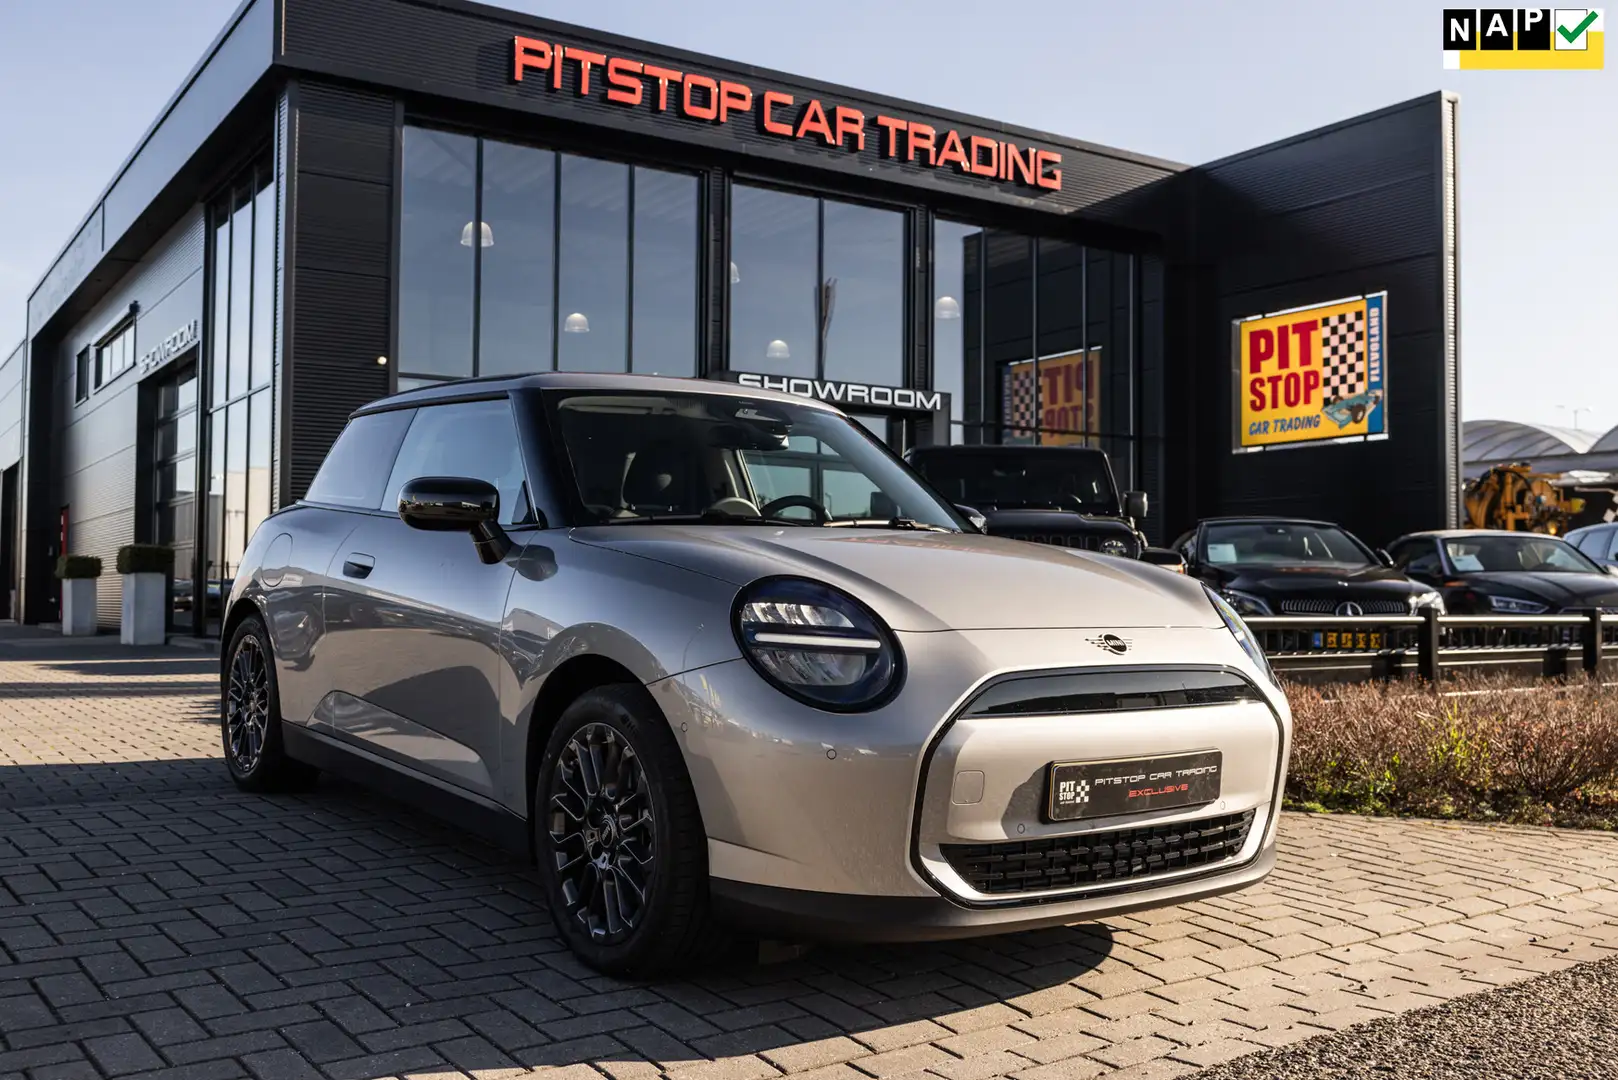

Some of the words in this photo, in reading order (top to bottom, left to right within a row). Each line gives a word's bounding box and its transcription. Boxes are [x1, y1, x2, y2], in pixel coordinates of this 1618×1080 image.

[514, 35, 753, 123] PITSTOP
[763, 90, 865, 150] CAR
[877, 115, 1062, 191] TRADING
[1249, 319, 1319, 374] PIT
[738, 373, 941, 410] SHOWROOM
[1250, 370, 1320, 413] STOP
[1248, 419, 1271, 436] CAR
[1273, 414, 1321, 434] TRADING
[1060, 780, 1076, 792] PIT
[1095, 774, 1147, 786] PITSTOP
[1149, 771, 1172, 781] CAR
[1175, 765, 1218, 777] TRADING
[1059, 791, 1076, 801] STOP
[1128, 783, 1189, 798] EXCLUSIVE
